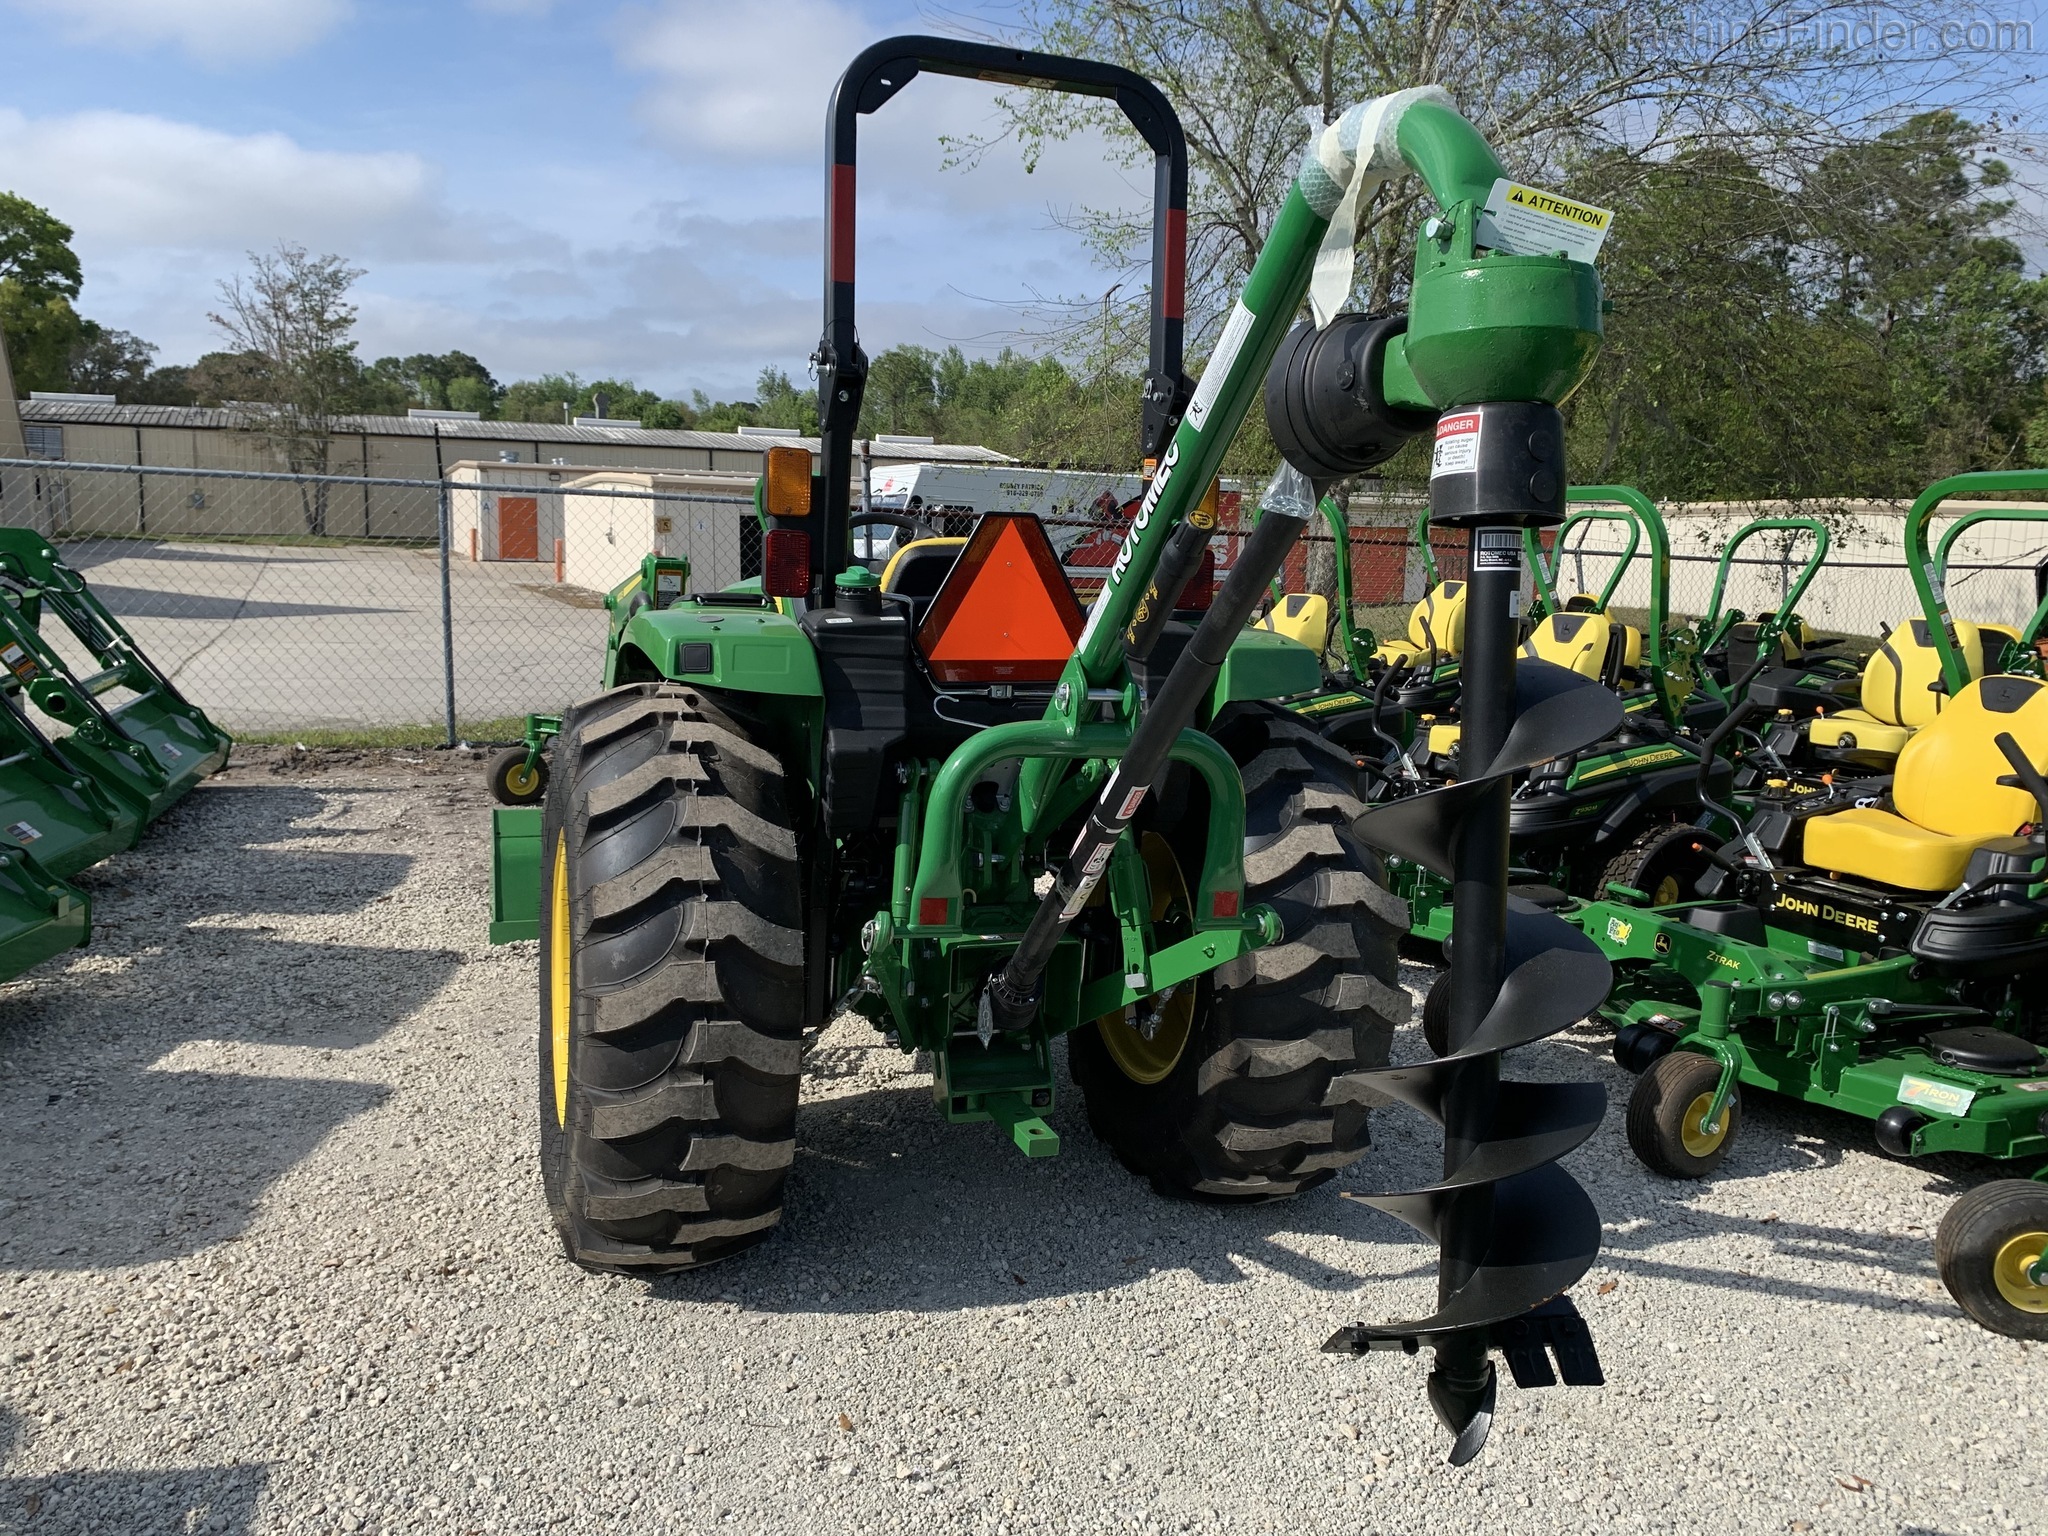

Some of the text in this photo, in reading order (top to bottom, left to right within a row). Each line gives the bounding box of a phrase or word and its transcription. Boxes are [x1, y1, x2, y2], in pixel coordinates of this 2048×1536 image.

[1528, 195, 1603, 226] ATTENTION
[1440, 419, 1474, 436] DANGER
[1317, 702, 1334, 710] JOHN
[1629, 751, 1674, 767] JOHN DEERE
[1776, 893, 1880, 934] JOHN DEERE
[1706, 950, 1741, 970] ZTRAK
